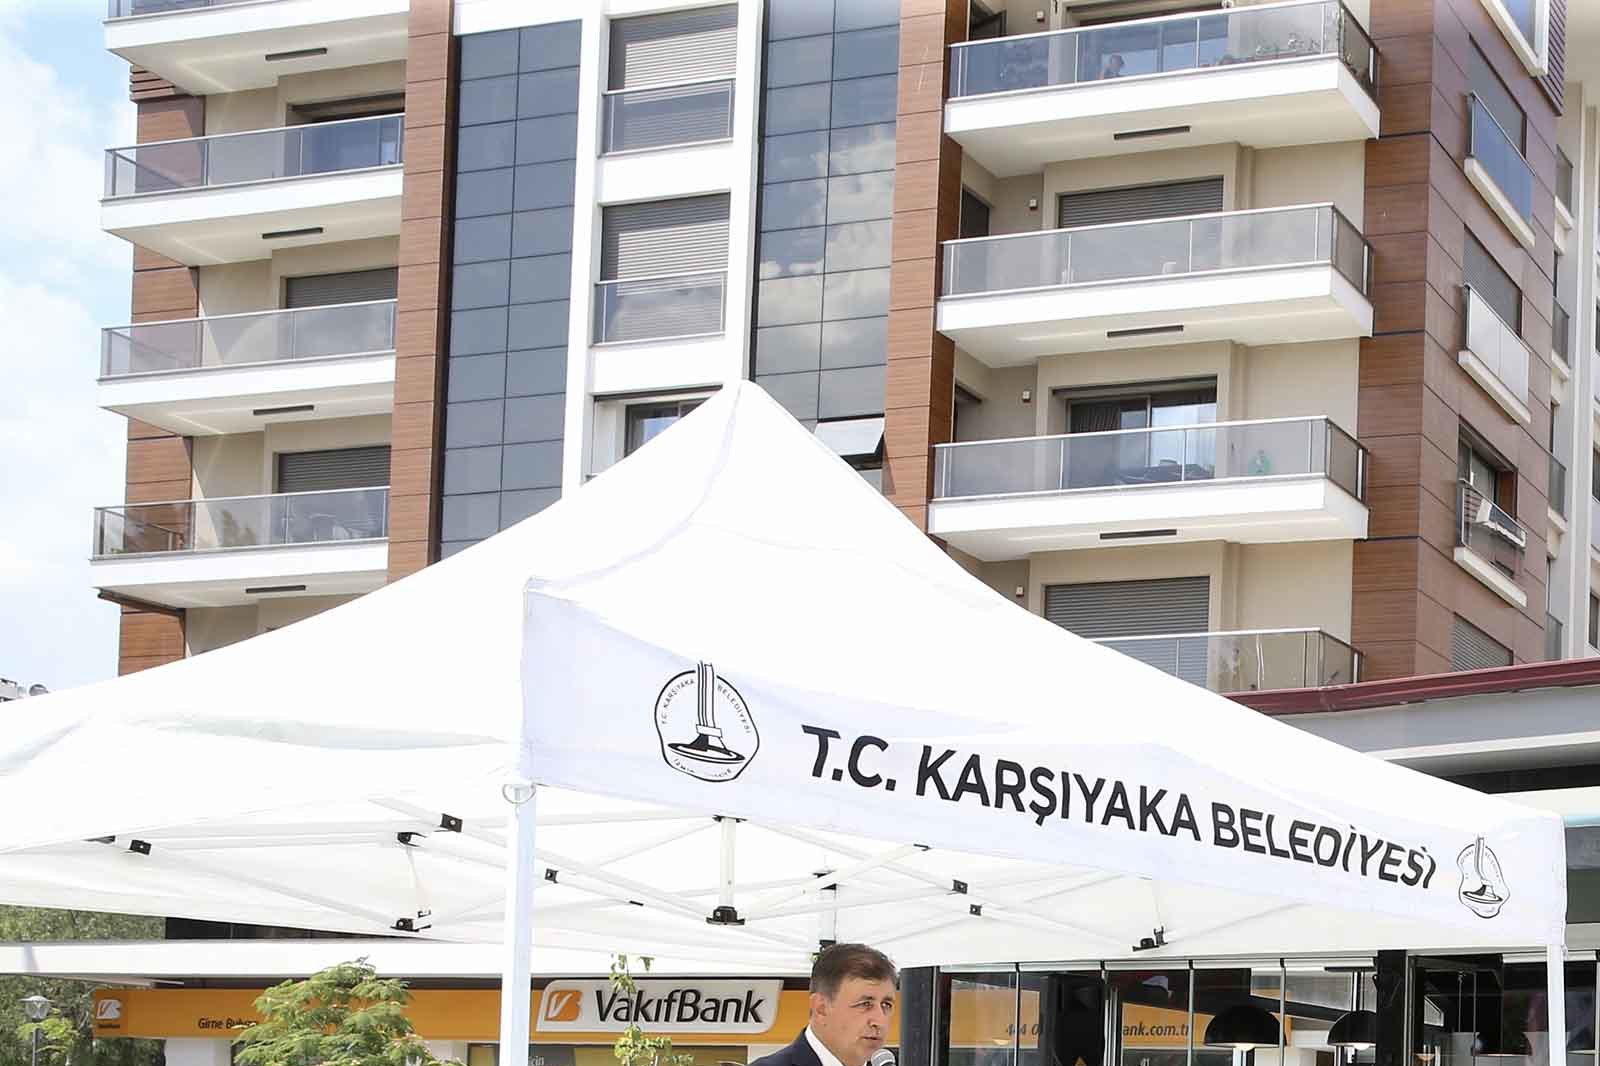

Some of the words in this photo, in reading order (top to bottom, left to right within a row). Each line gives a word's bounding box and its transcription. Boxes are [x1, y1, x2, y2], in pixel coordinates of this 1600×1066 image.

[801, 724, 896, 791] T.C.
[915, 744, 1202, 842] KARŞIYAKA
[1211, 801, 1437, 889] BELEDİYESİ
[595, 988, 765, 1023] VakıfBank
